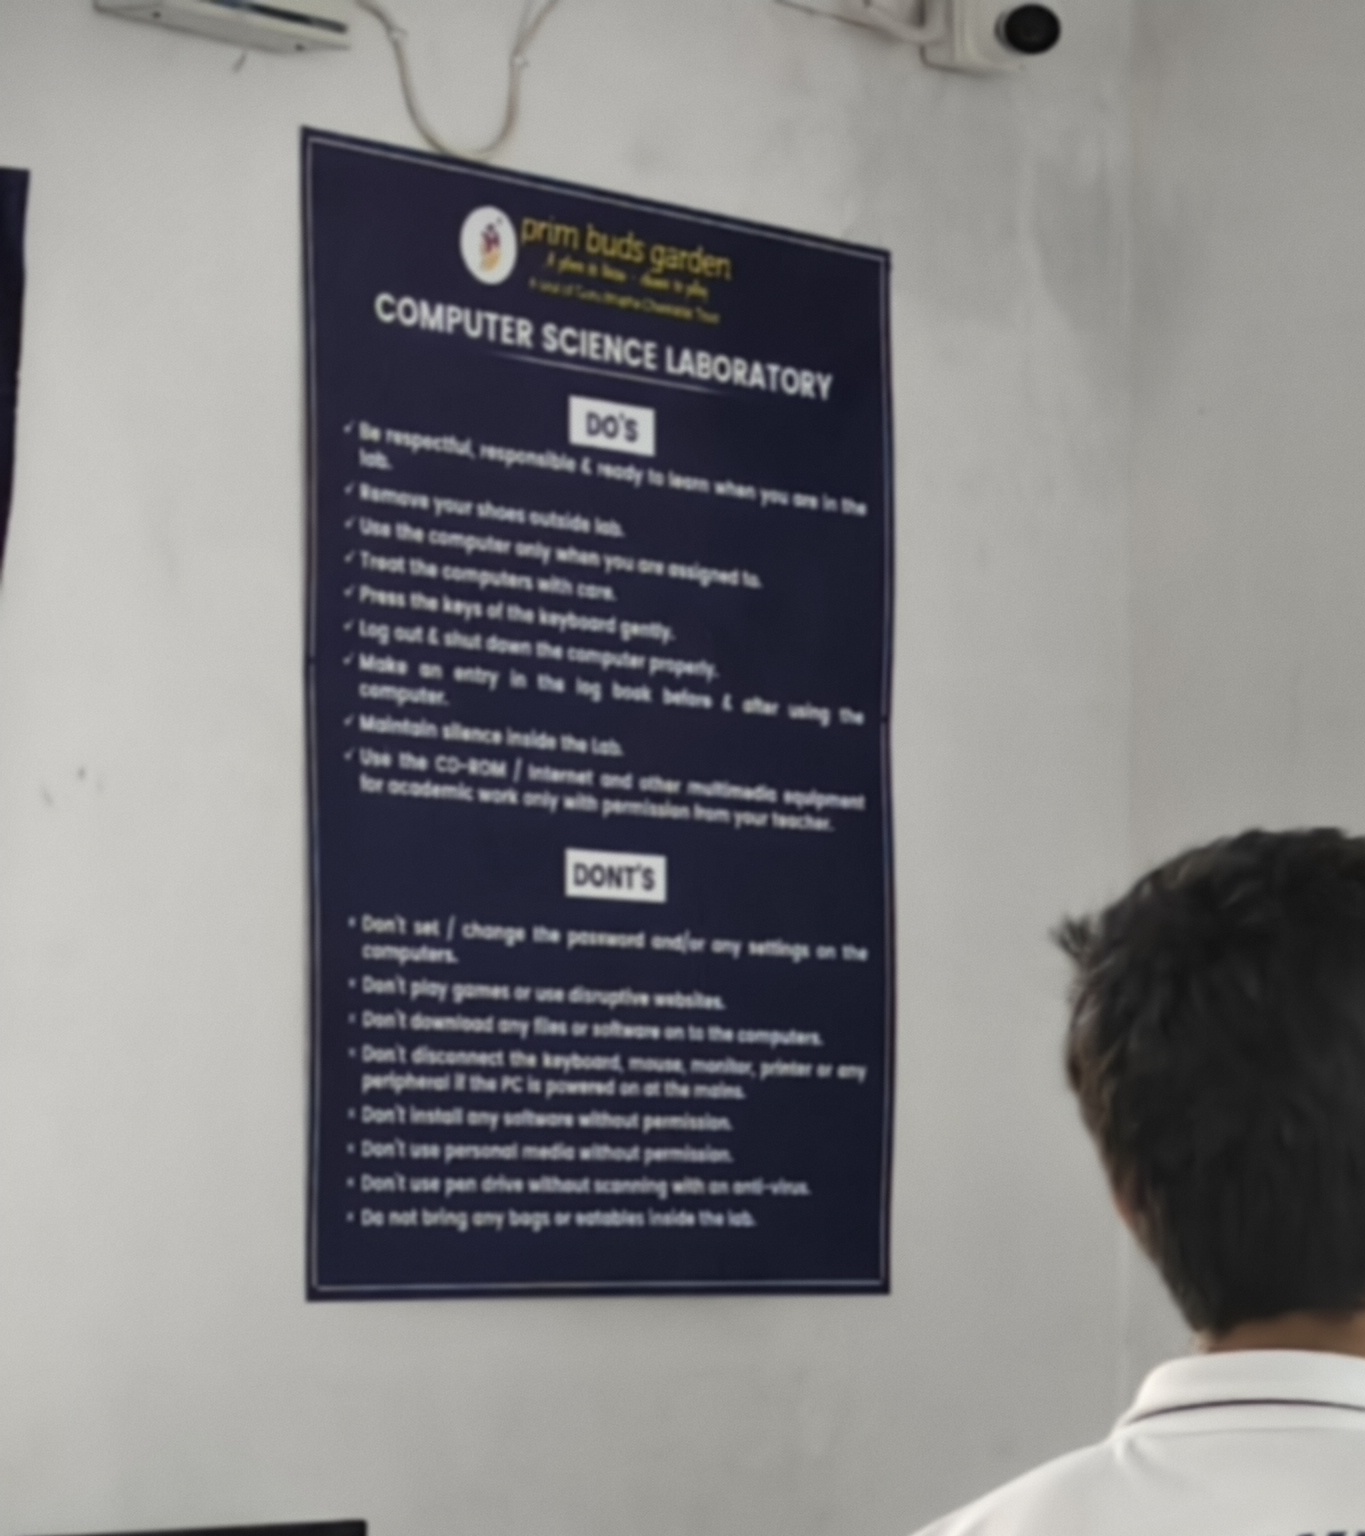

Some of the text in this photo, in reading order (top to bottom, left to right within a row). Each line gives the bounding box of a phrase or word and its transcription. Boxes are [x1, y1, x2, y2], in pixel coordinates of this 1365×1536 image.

[520, 217, 579, 249] prim
[585, 223, 645, 263] buds
[650, 244, 732, 280] garden
[374, 292, 533, 349] COMPUTER
[542, 323, 658, 371] SCIENCE
[665, 345, 834, 401] LABORATORY
[585, 410, 640, 443] DO'S
[571, 861, 656, 891] DONT'S
